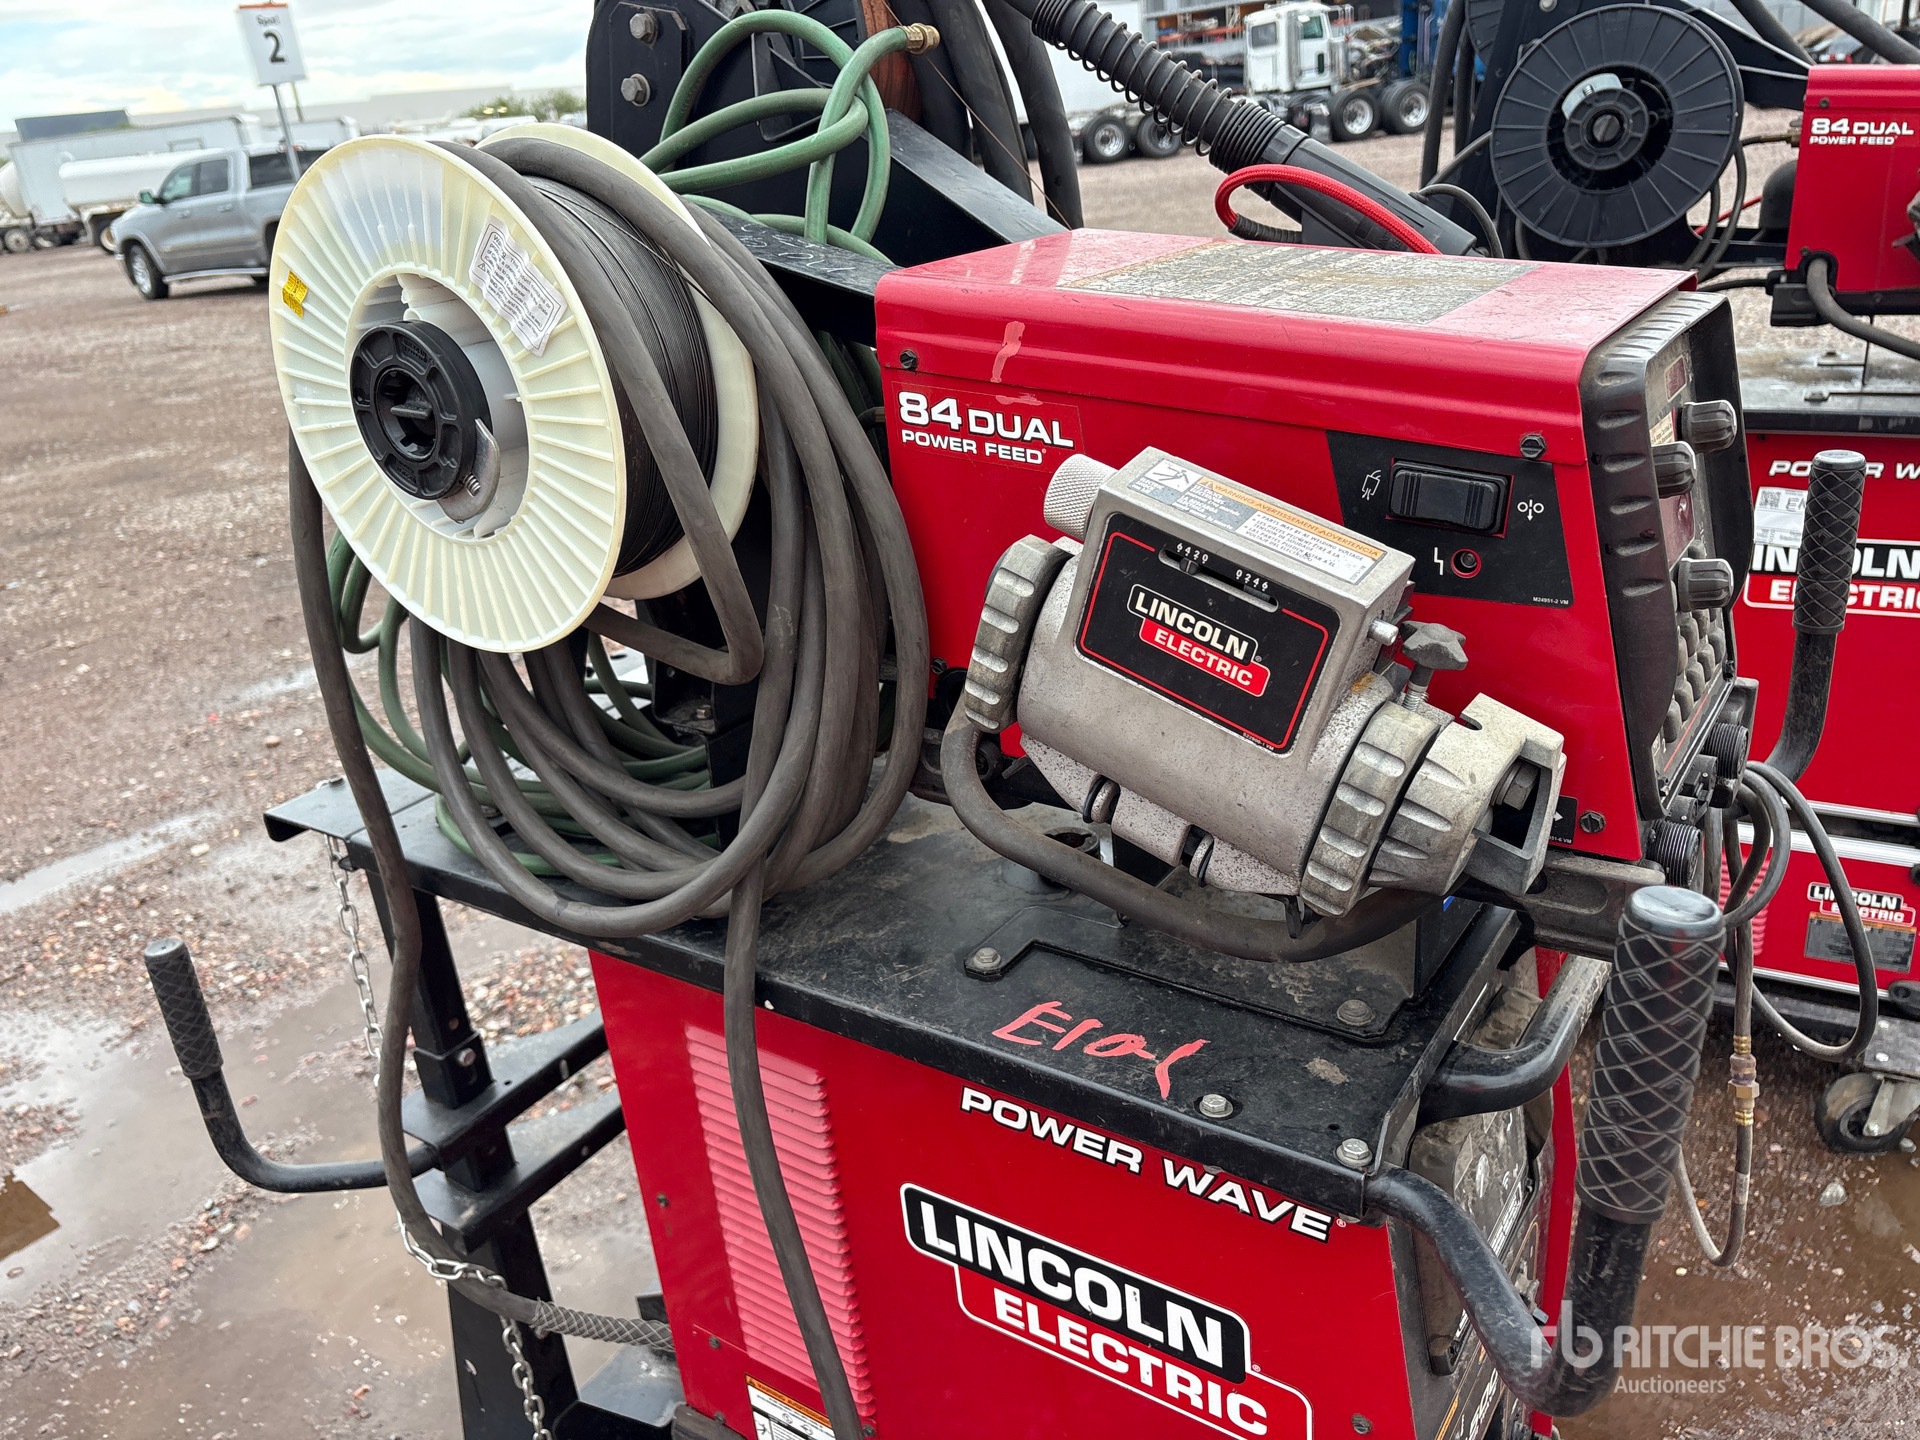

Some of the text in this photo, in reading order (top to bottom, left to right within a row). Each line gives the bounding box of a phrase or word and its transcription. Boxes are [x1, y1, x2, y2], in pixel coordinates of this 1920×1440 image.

[263, 31, 286, 63] 2
[1809, 136, 1895, 145] POWER FEED
[1811, 118, 1914, 135] 84 DUAL
[898, 391, 1075, 448] 84 DUAL
[901, 430, 1044, 465] POWER FEED
[1768, 460, 1885, 478] POR
[1212, 484, 1380, 557] WARNING AVERTISSEMENT ADVERTENCIA
[1135, 591, 1249, 660] LINCOLN
[1154, 628, 1253, 686] ELECTRIC
[961, 1087, 1333, 1241] POWER WAVE
[920, 1200, 1223, 1369] LINCOLN
[994, 1286, 1269, 1437] ELECTRIC
